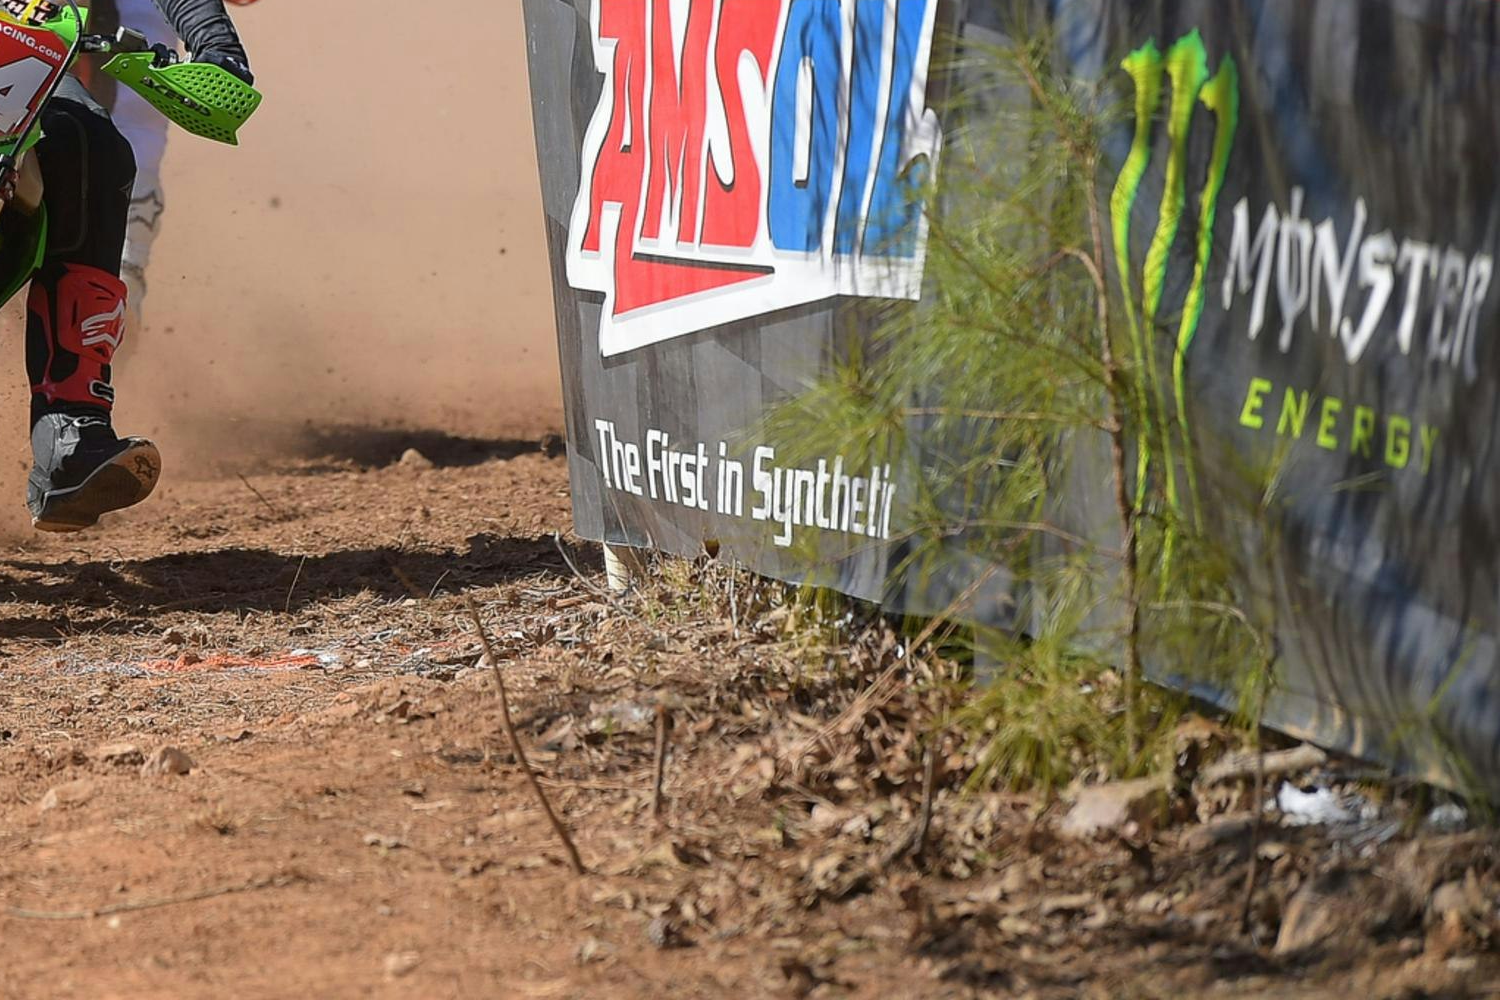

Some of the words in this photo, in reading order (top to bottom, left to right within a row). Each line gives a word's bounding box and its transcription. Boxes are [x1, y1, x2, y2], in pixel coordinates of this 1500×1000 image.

[1222, 186, 1494, 384] MONSTER
[595, 418, 642, 497] The
[646, 427, 710, 513] First
[717, 439, 743, 518] in
[1239, 376, 1440, 475] ENERGY
